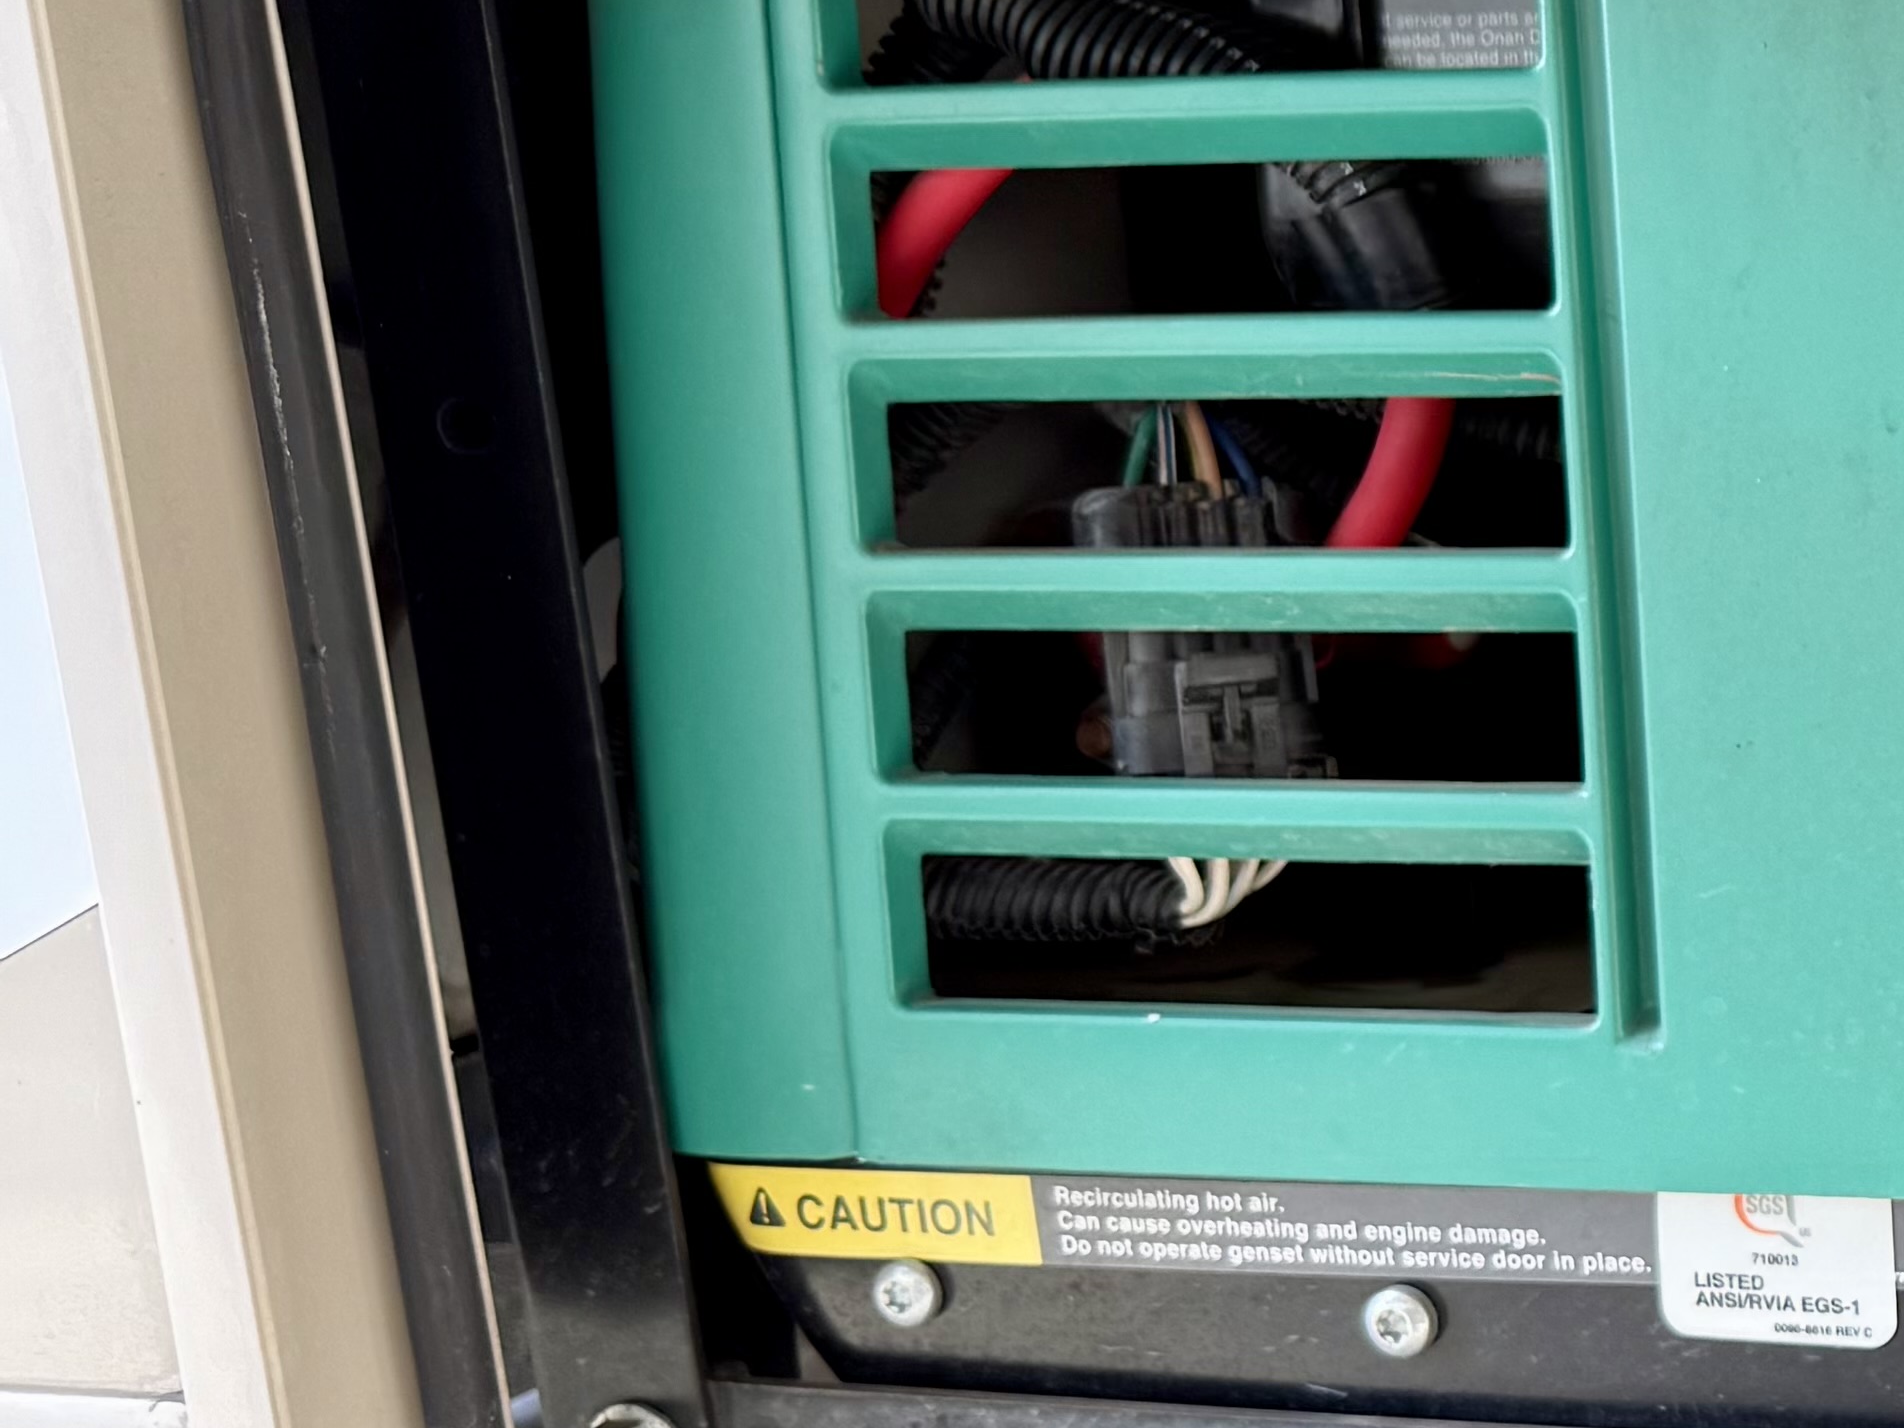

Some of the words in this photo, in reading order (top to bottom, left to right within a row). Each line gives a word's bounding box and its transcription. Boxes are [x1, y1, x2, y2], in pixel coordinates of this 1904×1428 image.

[797, 1194, 995, 1236] CAUTION
[1054, 1186, 1200, 1215] Recirculating
[1206, 1192, 1242, 1212] hot
[1249, 1193, 1284, 1213] air.
[1746, 1195, 1784, 1215] SGS
[1057, 1211, 1100, 1231] Can
[1106, 1215, 1171, 1234] cause
[1177, 1217, 1309, 1243] overheating
[1316, 1221, 1357, 1240] and
[1365, 1223, 1441, 1246] engine
[1450, 1224, 1546, 1250] damage.
[1061, 1234, 1091, 1255] Do
[1098, 1238, 1133, 1256] not
[1140, 1240, 1222, 1261] operate
[1229, 1243, 1303, 1266] genset
[1310, 1245, 1394, 1266] without
[1402, 1248, 1485, 1268] service
[1492, 1250, 1546, 1270] door
[1554, 1252, 1574, 1270] in
[1582, 1252, 1652, 1275] place.
[1694, 1271, 1764, 1291] LISTED
[1696, 1292, 1795, 1312] ANSI/RVIA
[1802, 1297, 1860, 1315] EGS-1
